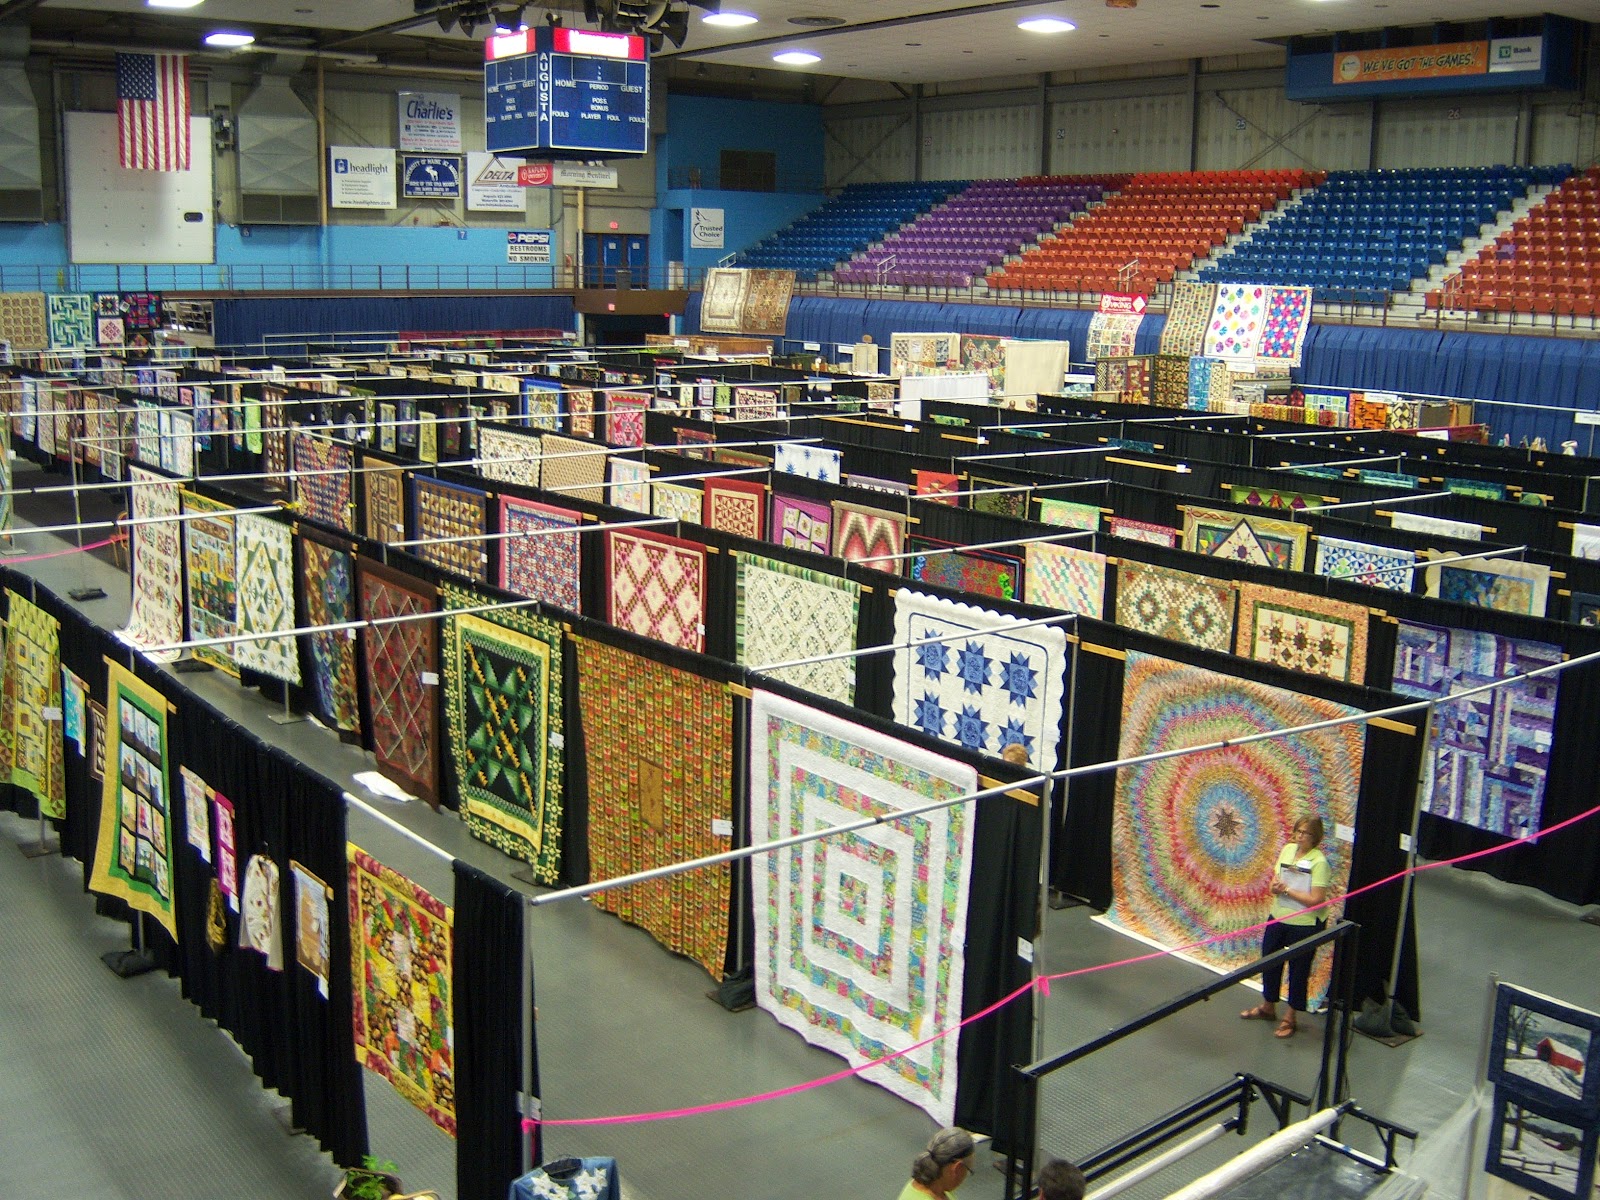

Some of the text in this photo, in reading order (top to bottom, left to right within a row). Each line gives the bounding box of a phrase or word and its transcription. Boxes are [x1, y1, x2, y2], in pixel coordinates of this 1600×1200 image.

[1363, 60, 1395, 73] WE'VE
[1397, 58, 1416, 70] GOT
[1419, 57, 1435, 69] THE
[540, 53, 549, 121] AUGUSTA
[555, 79, 576, 88] HOME
[621, 85, 643, 93] GUEST
[407, 100, 453, 120] Charlie's
[581, 112, 601, 120] PLAYER
[350, 163, 388, 175] headlight
[484, 171, 515, 180] DELTA
[517, 233, 549, 243] PEPSI
